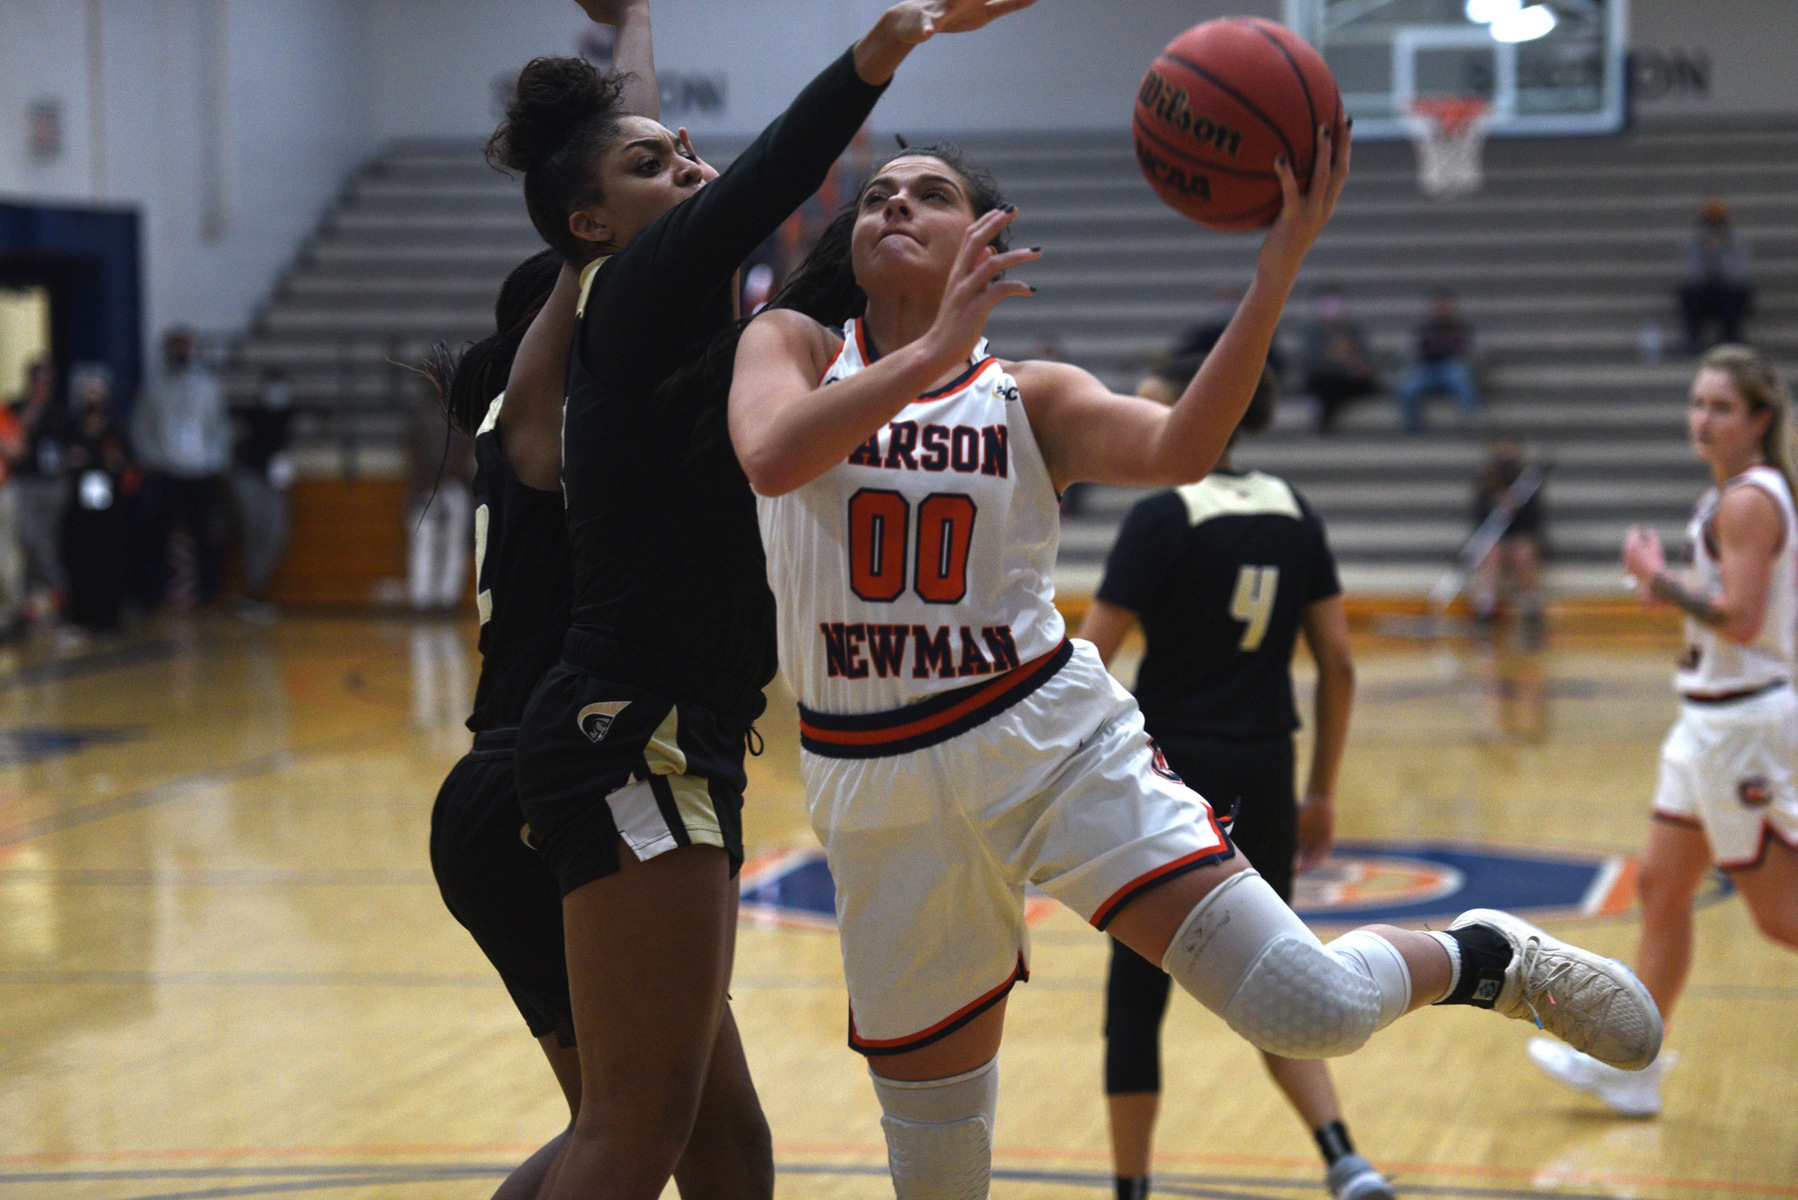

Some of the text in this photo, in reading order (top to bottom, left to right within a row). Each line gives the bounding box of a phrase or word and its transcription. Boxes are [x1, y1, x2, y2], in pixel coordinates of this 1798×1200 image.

[1139, 70, 1242, 158] Wilson
[848, 420, 1008, 479] ARSON
[848, 487, 978, 605] 00
[820, 622, 1020, 679] NEWMAN
[1230, 563, 1280, 652] 4
